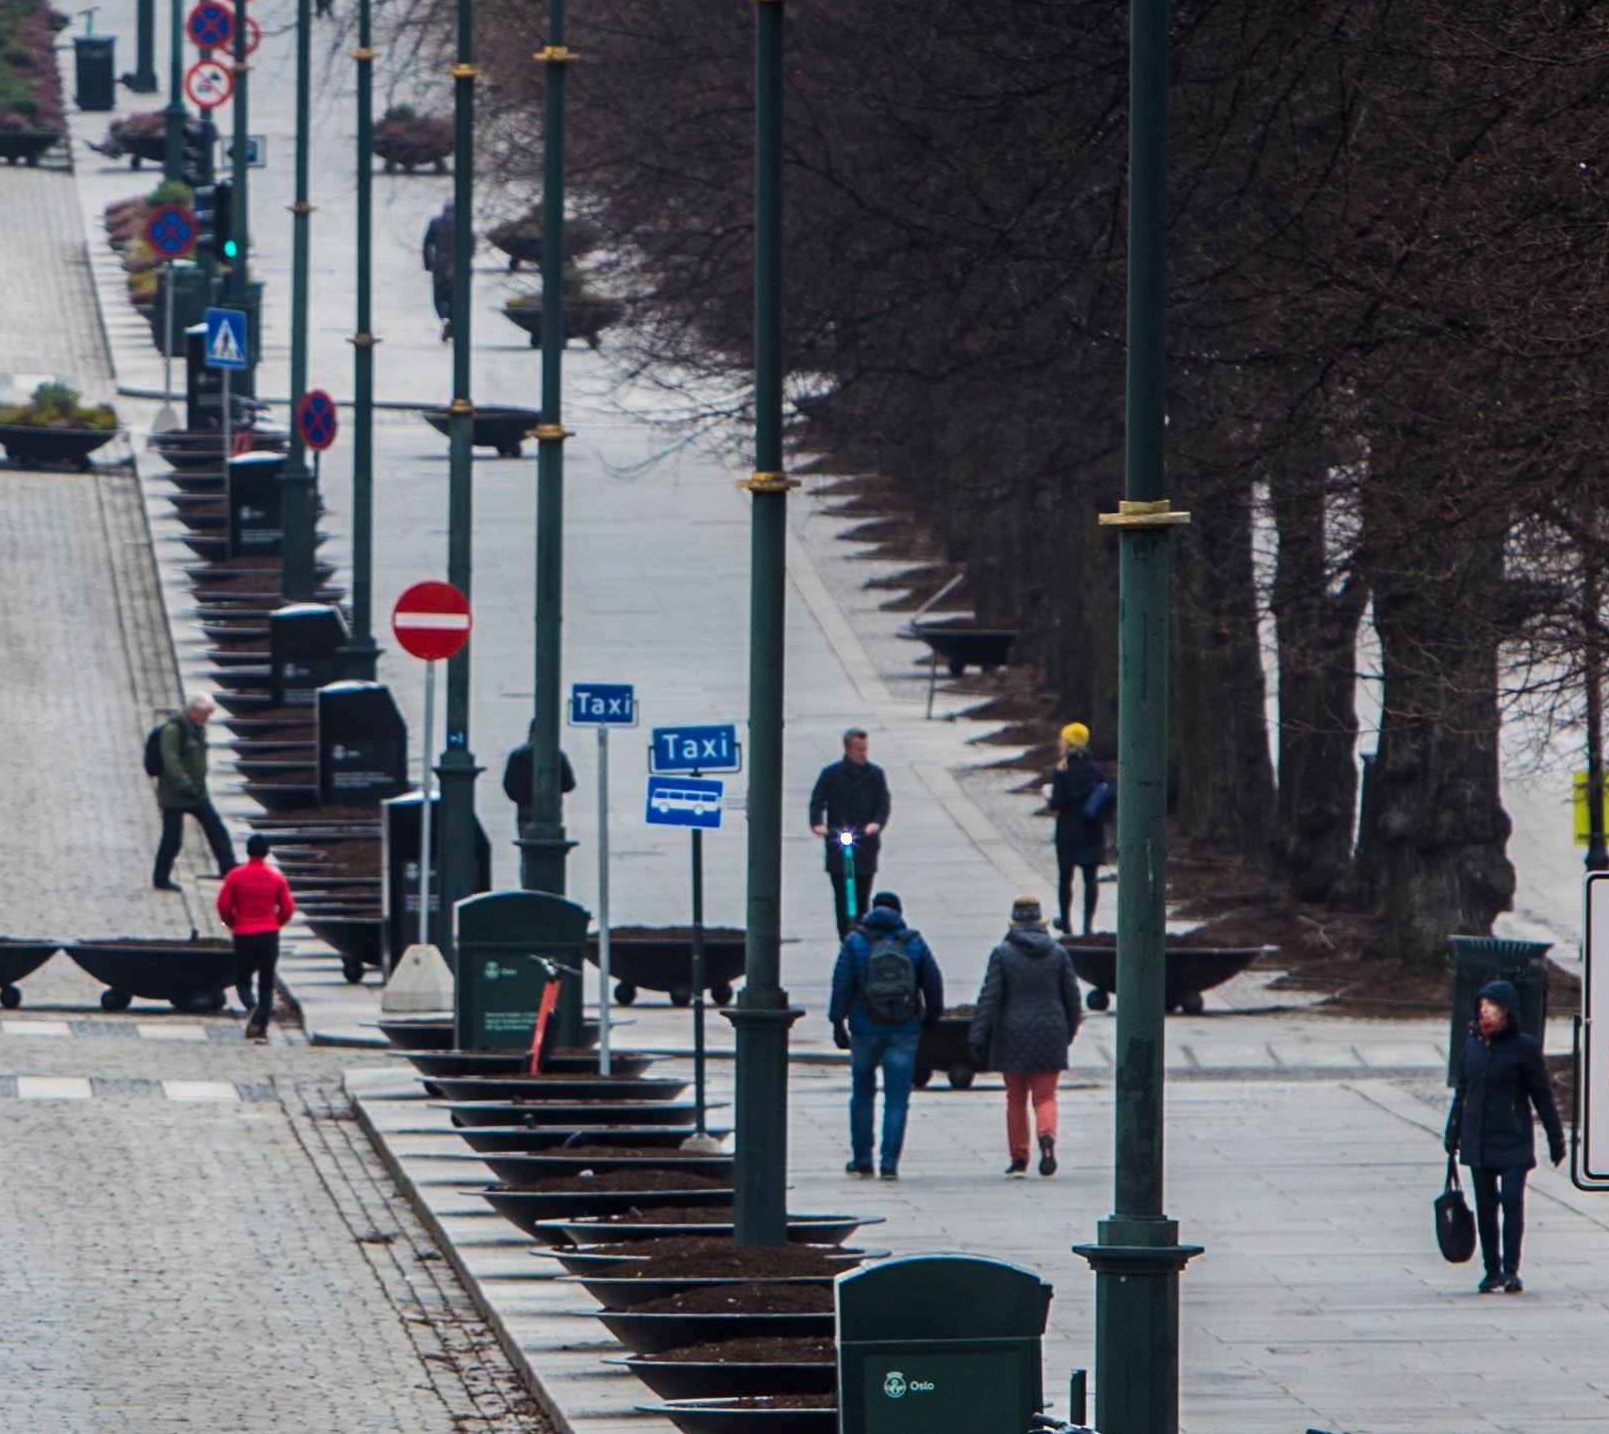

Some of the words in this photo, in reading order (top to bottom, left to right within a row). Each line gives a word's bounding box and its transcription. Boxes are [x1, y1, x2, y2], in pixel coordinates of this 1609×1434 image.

[576, 691, 631, 715] Taxi
[661, 730, 728, 761] Taxi
[910, 1380, 935, 1391] Oslo
